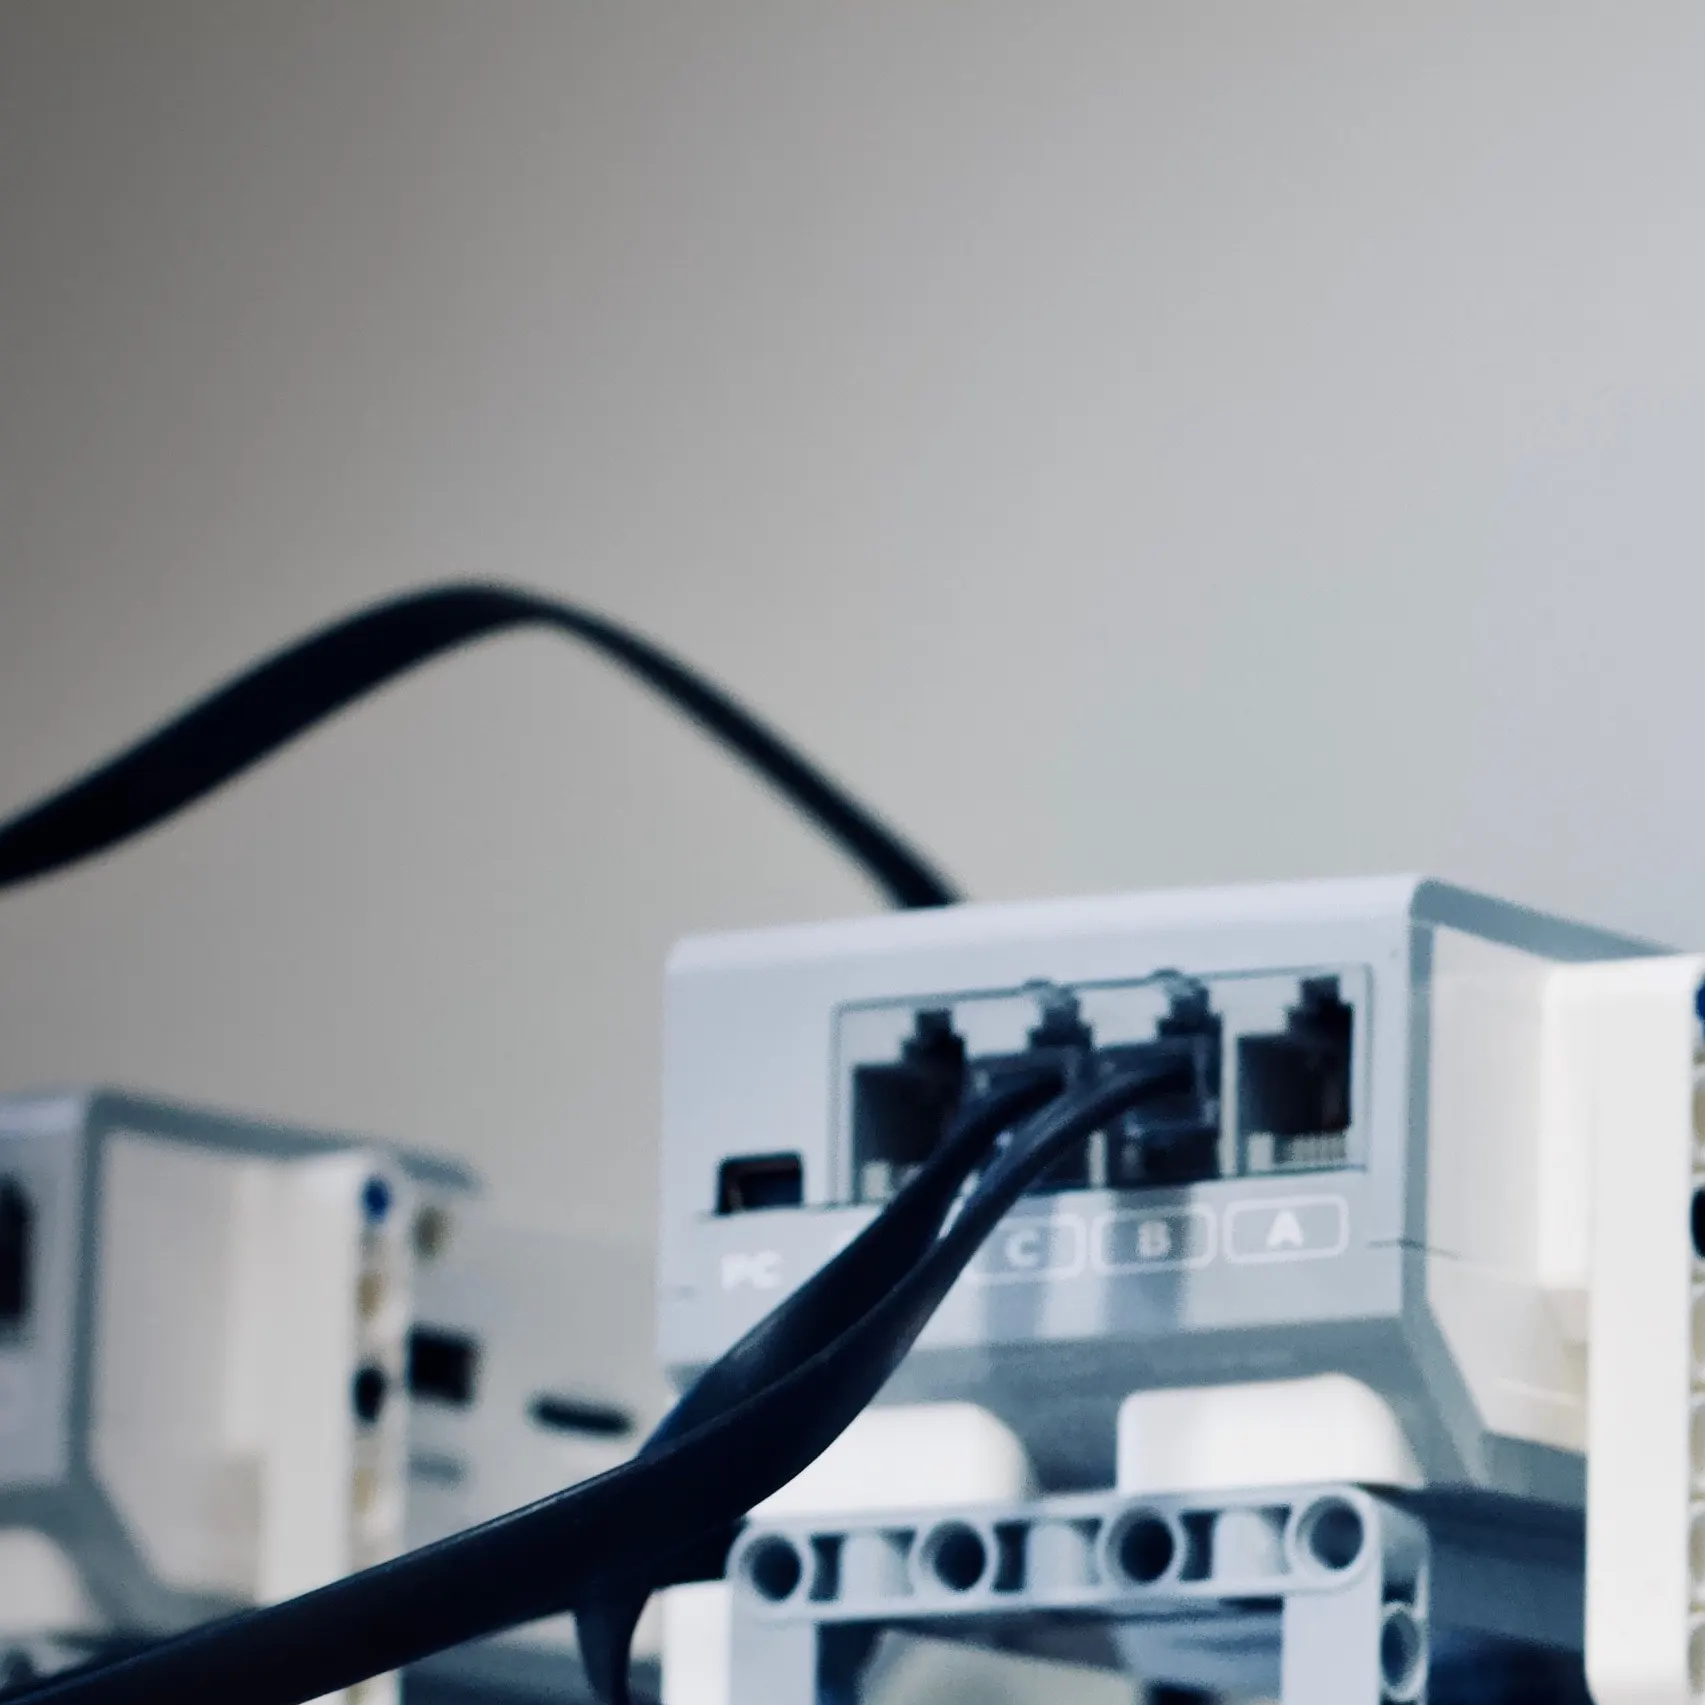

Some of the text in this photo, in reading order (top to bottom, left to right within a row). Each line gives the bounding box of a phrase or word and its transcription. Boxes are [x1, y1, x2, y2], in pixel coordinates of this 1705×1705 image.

[1005, 1229, 1043, 1266] C
[1137, 1220, 1174, 1257] B
[1266, 1210, 1304, 1249] A
